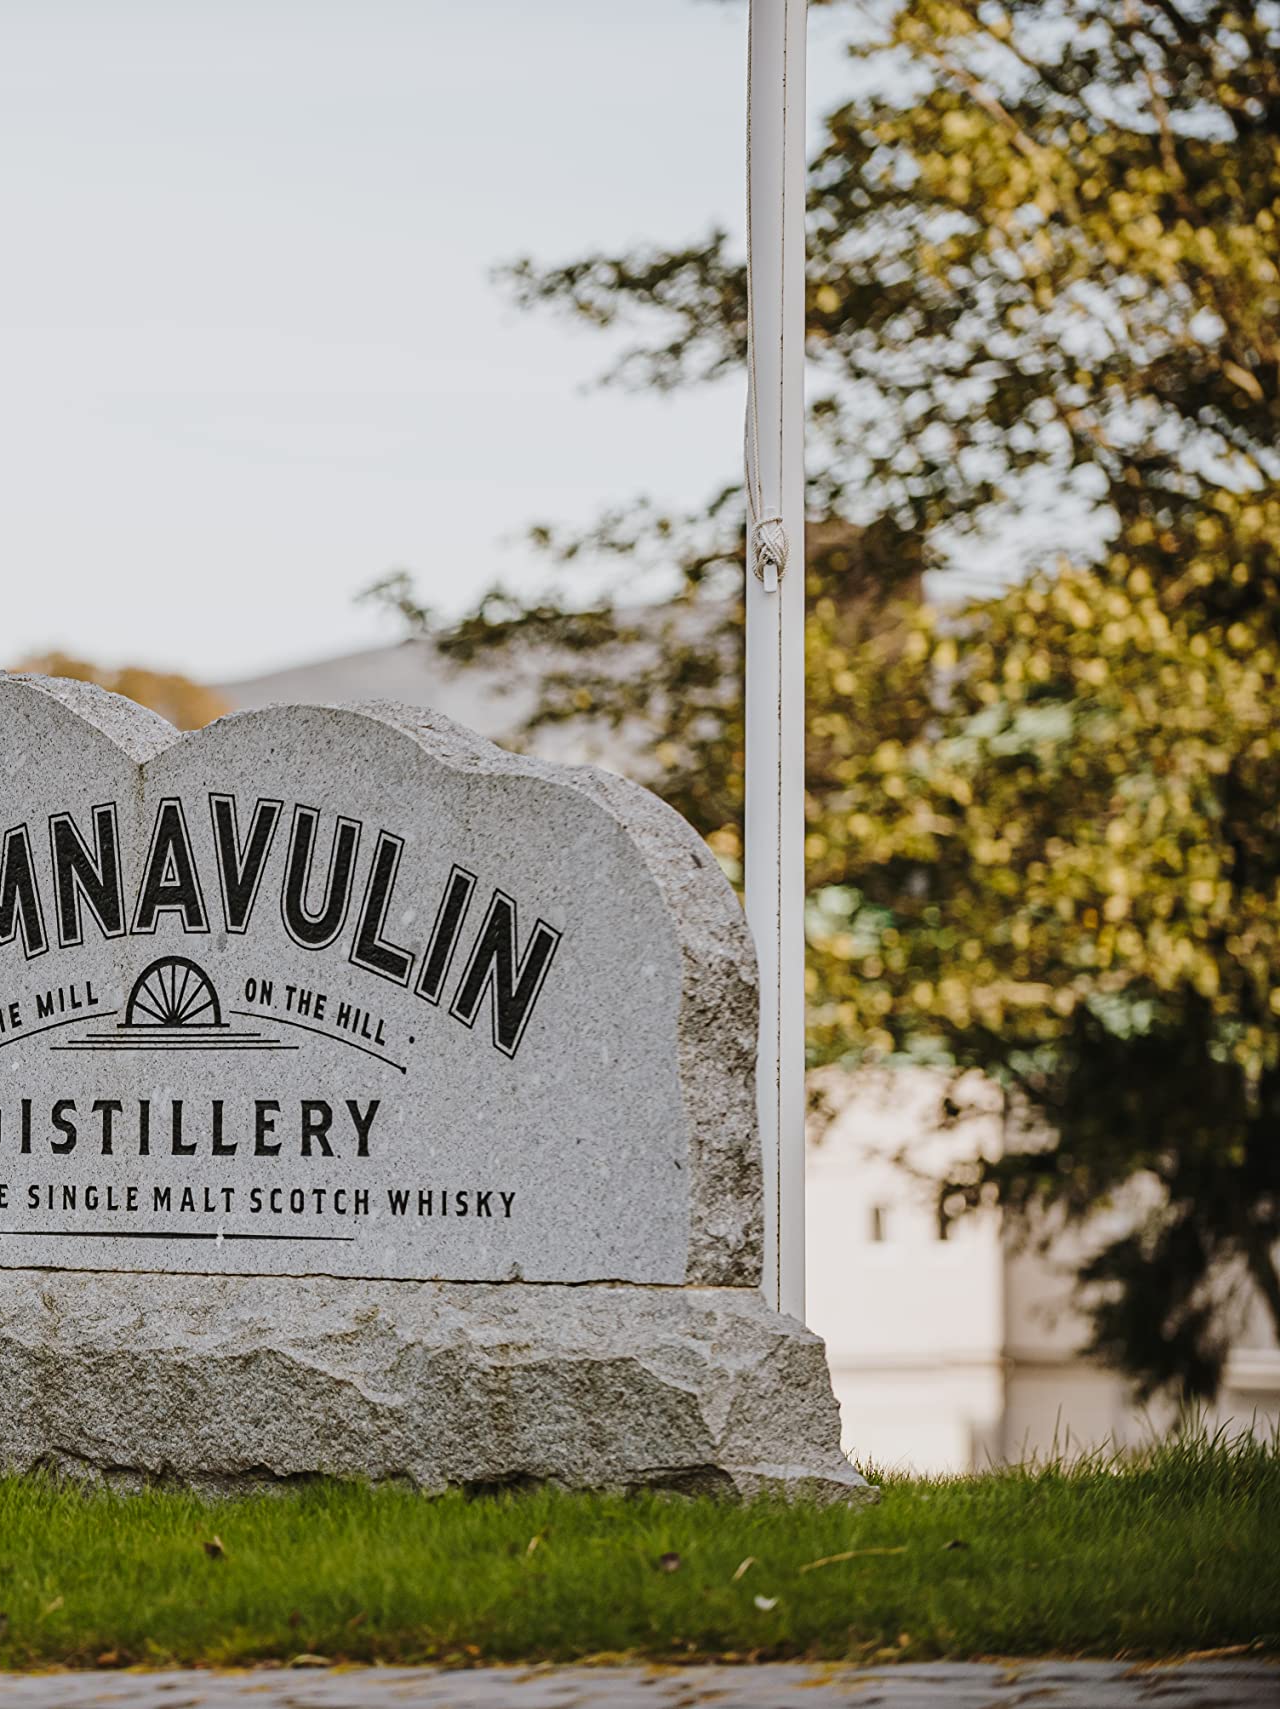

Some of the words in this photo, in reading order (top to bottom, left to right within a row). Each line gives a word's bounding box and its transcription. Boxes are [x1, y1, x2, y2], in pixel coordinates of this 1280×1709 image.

[36, 980, 99, 1019] MILL
[245, 977, 274, 1007] ON
[286, 985, 327, 1020] THE
[336, 1002, 386, 1046] HILL
[27, 1185, 139, 1212] SINGLE
[154, 1187, 236, 1213] MALT
[249, 1188, 370, 1216] SCOTCH
[387, 1190, 516, 1219] WHISKY
